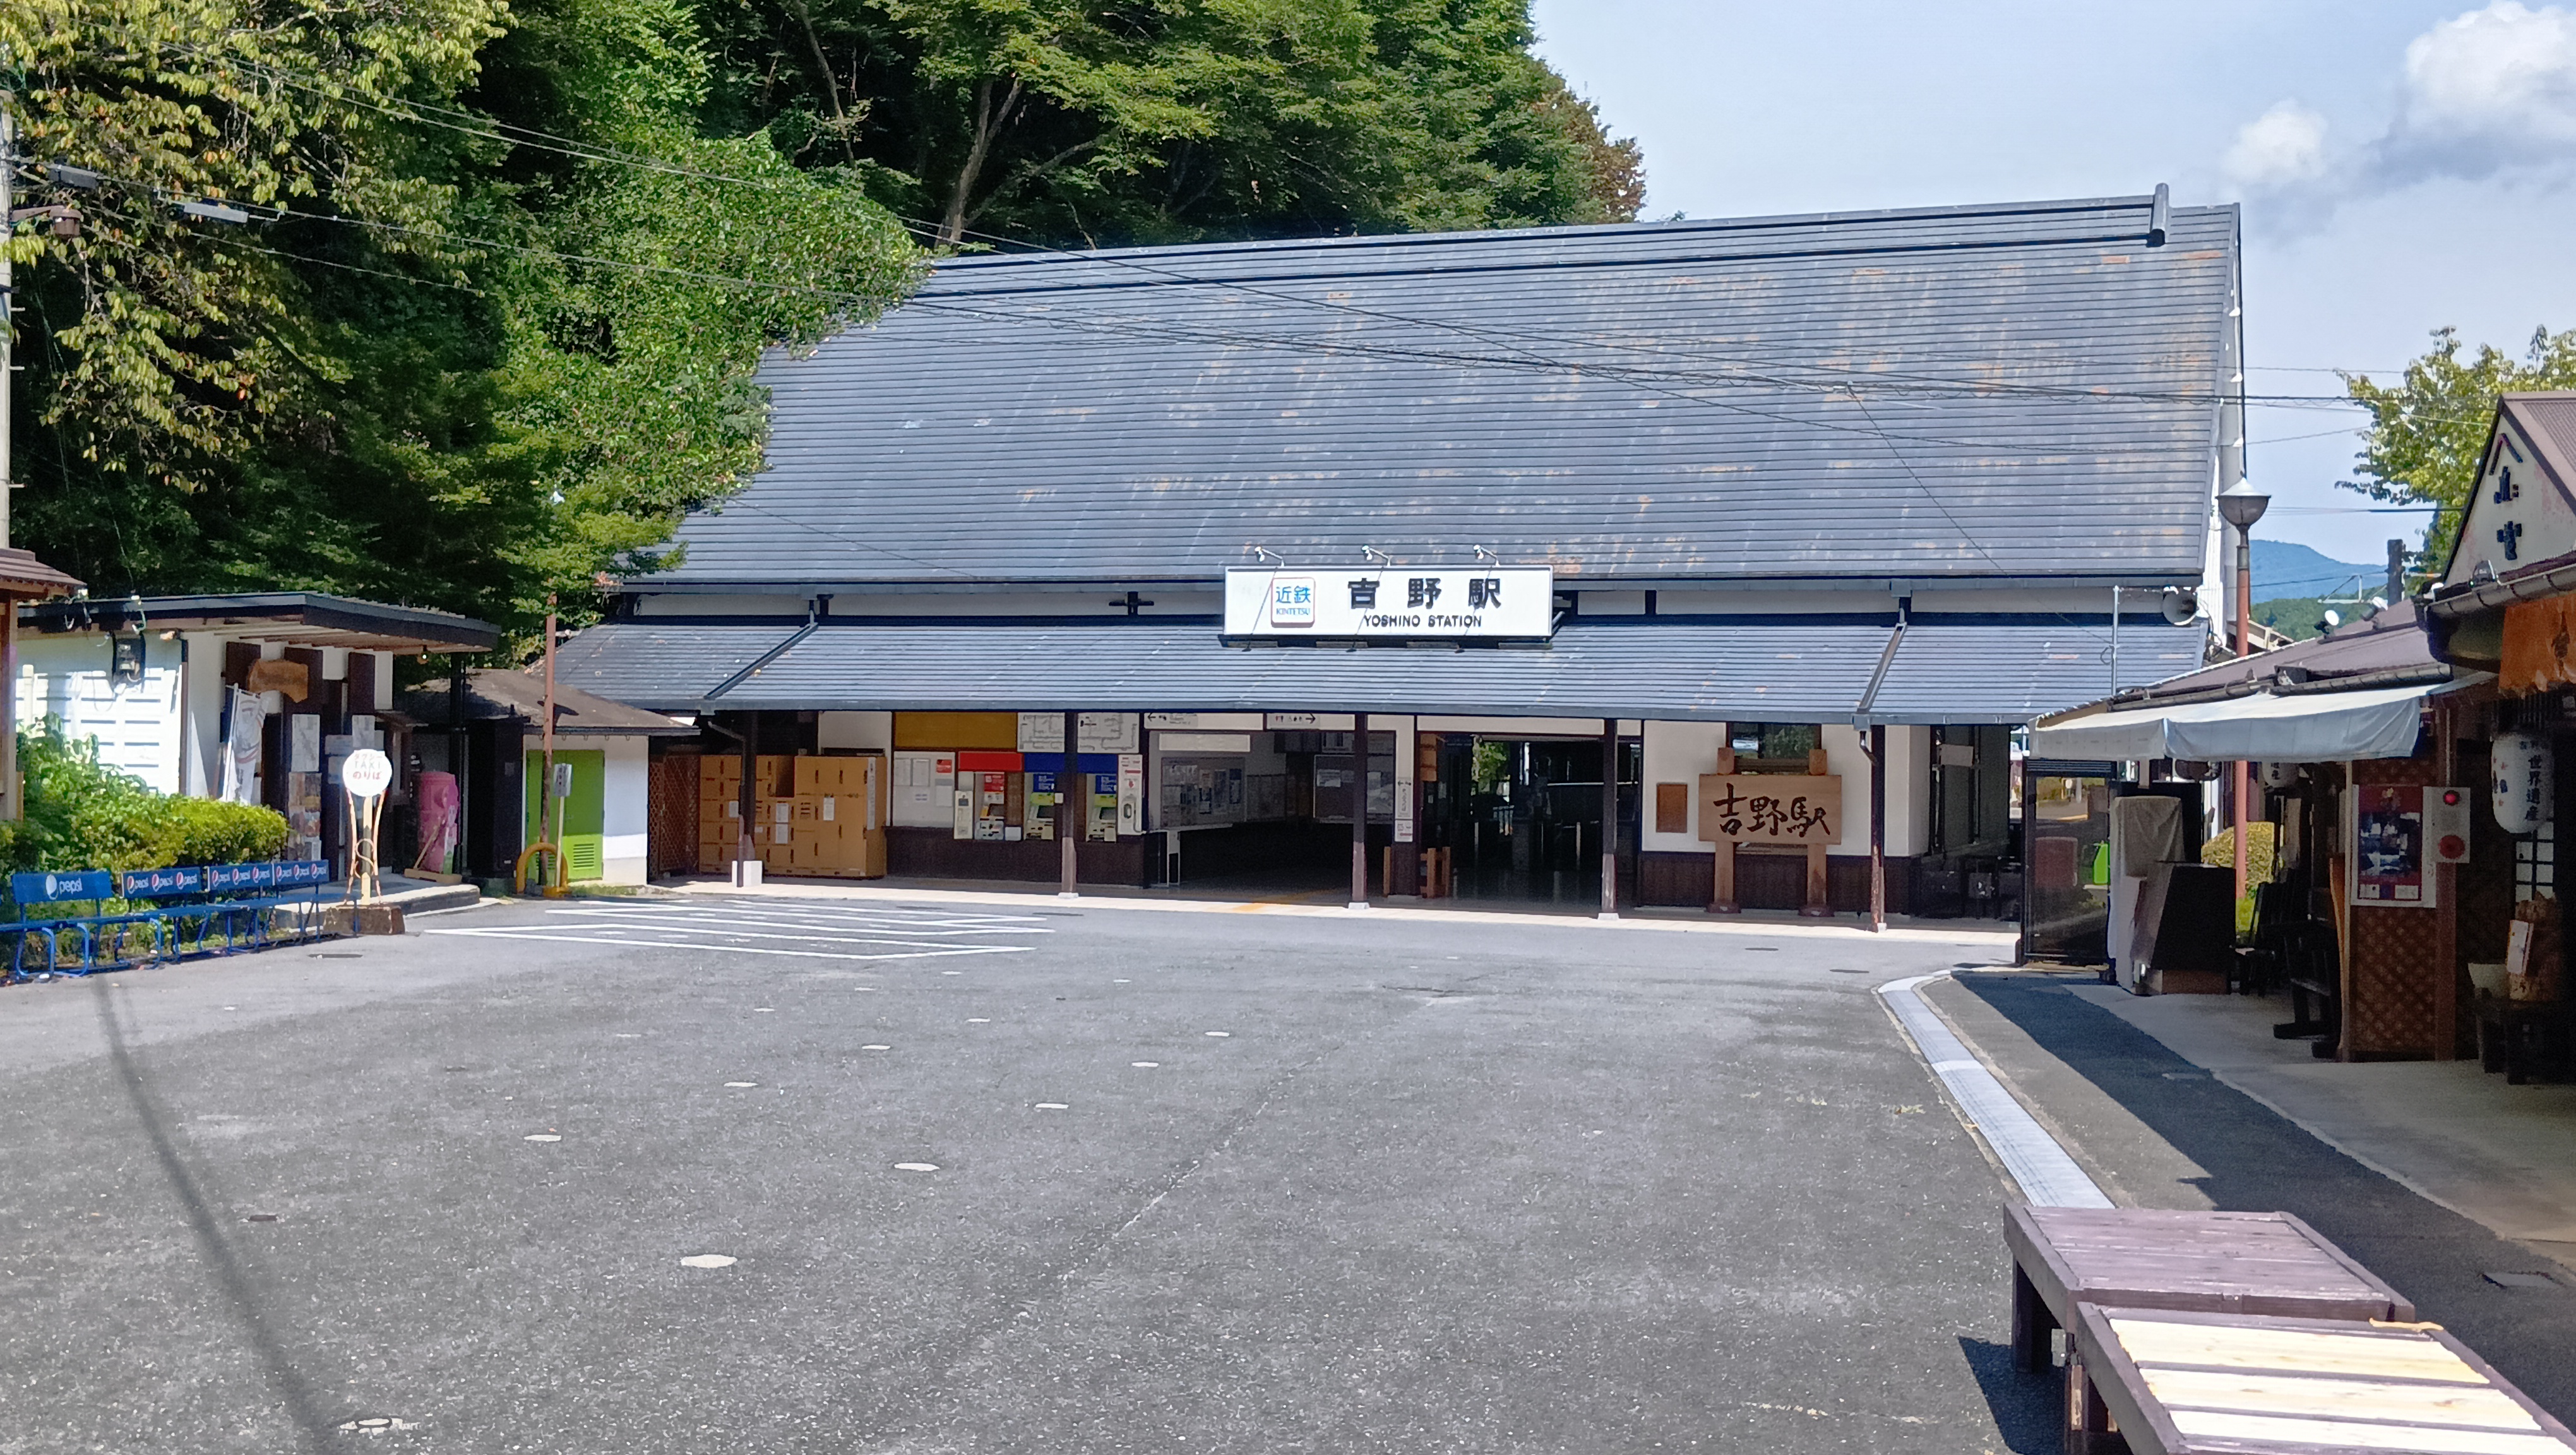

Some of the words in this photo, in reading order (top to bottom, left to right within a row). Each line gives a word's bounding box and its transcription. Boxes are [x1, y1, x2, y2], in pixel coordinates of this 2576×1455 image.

[1275, 585, 1311, 604] 近鉄
[1348, 578, 1501, 609] 吉野駅
[1276, 608, 1311, 616] KINTETSU
[1364, 614, 1421, 627] YOSHINO
[1428, 614, 1482, 628] STATION
[354, 760, 381, 769] TAXI
[353, 771, 382, 780] のりば
[1713, 782, 1830, 837] 吉野駅
[59, 878, 83, 895] pepsi
